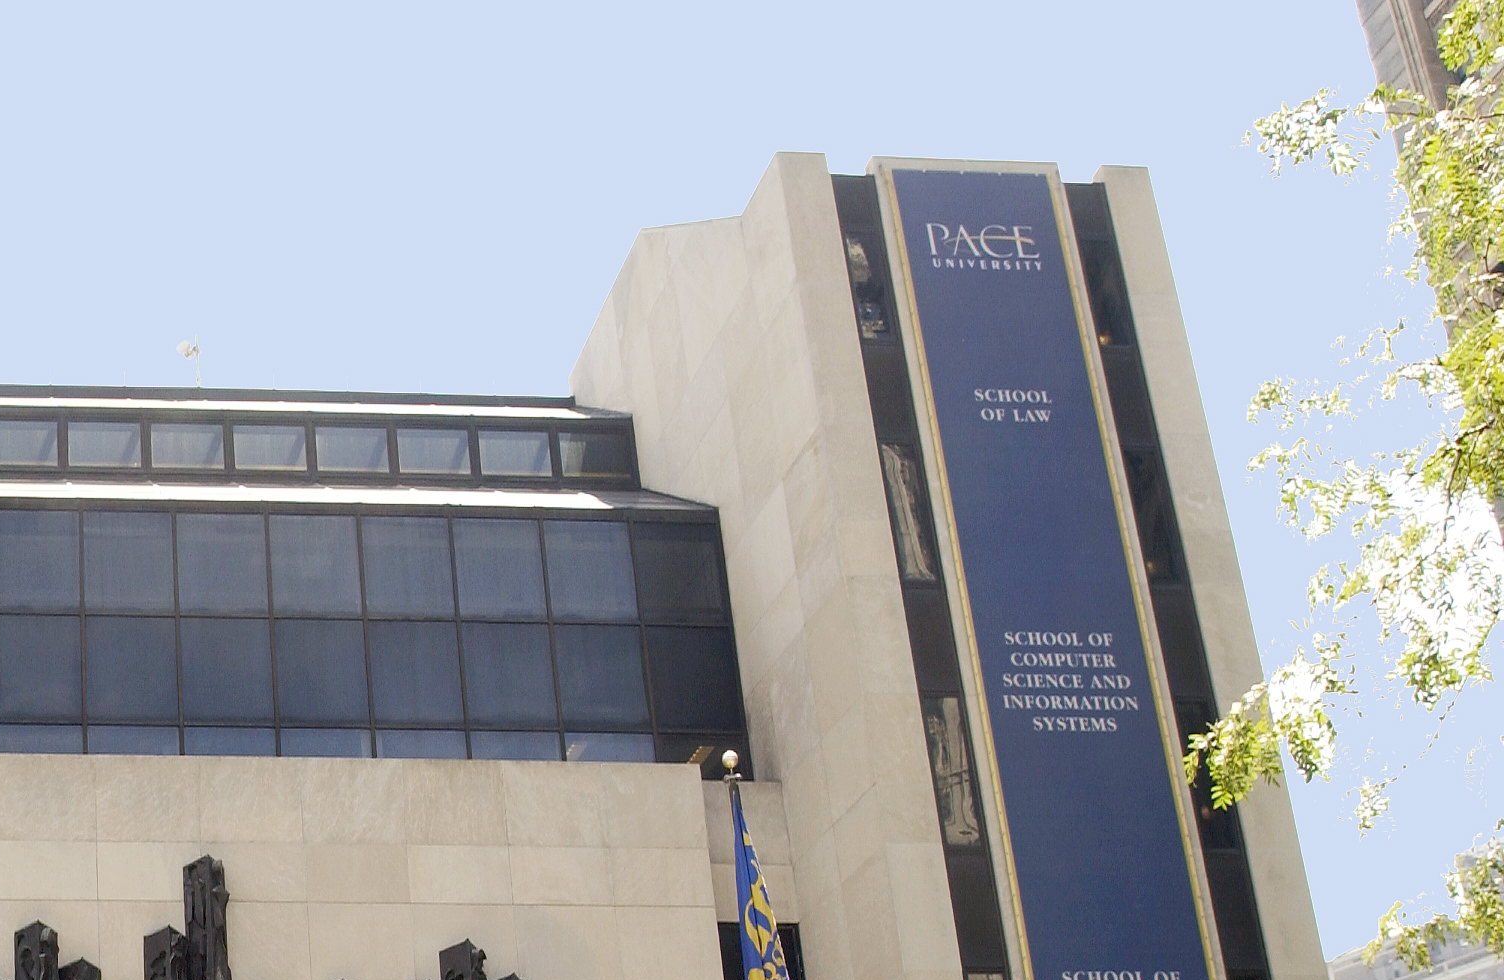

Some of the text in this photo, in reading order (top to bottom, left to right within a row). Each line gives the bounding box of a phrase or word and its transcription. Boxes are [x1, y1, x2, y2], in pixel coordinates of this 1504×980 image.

[926, 222, 1040, 258] PACE
[932, 258, 1042, 271] UNIVERSITY
[974, 388, 1053, 404] SCHOOL
[980, 408, 1051, 423] OF LAW
[1004, 631, 1113, 647] SCHOOL OF
[1010, 652, 1117, 669] COMPUTER
[1002, 673, 1131, 690] SCIENCE AND
[1003, 694, 1139, 712] INFORMATION
[1032, 716, 1118, 733] SYSTEMS
